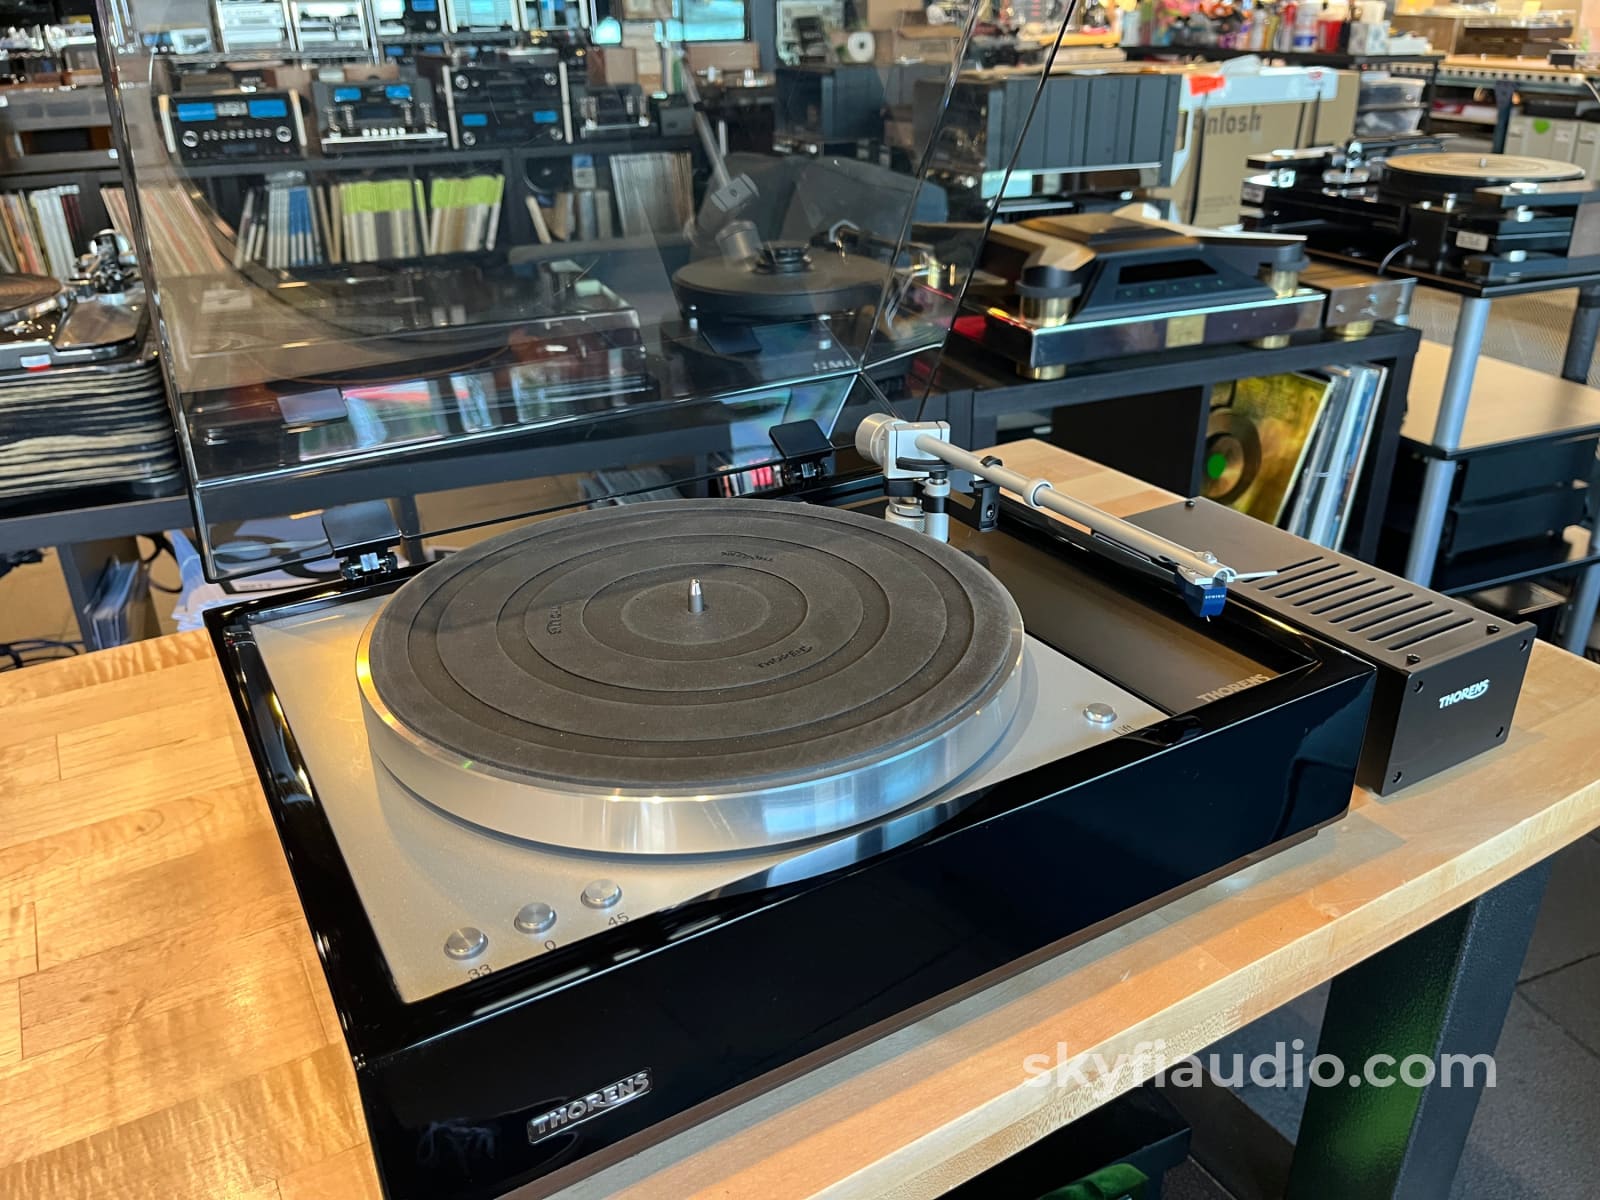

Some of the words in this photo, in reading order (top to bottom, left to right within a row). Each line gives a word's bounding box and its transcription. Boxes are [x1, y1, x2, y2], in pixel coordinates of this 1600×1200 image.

[1195, 673, 1271, 703] THORENS
[1439, 678, 1490, 709] THORENS
[607, 912, 629, 927] 45
[467, 963, 493, 981] 33
[531, 1072, 649, 1134] THORENS
